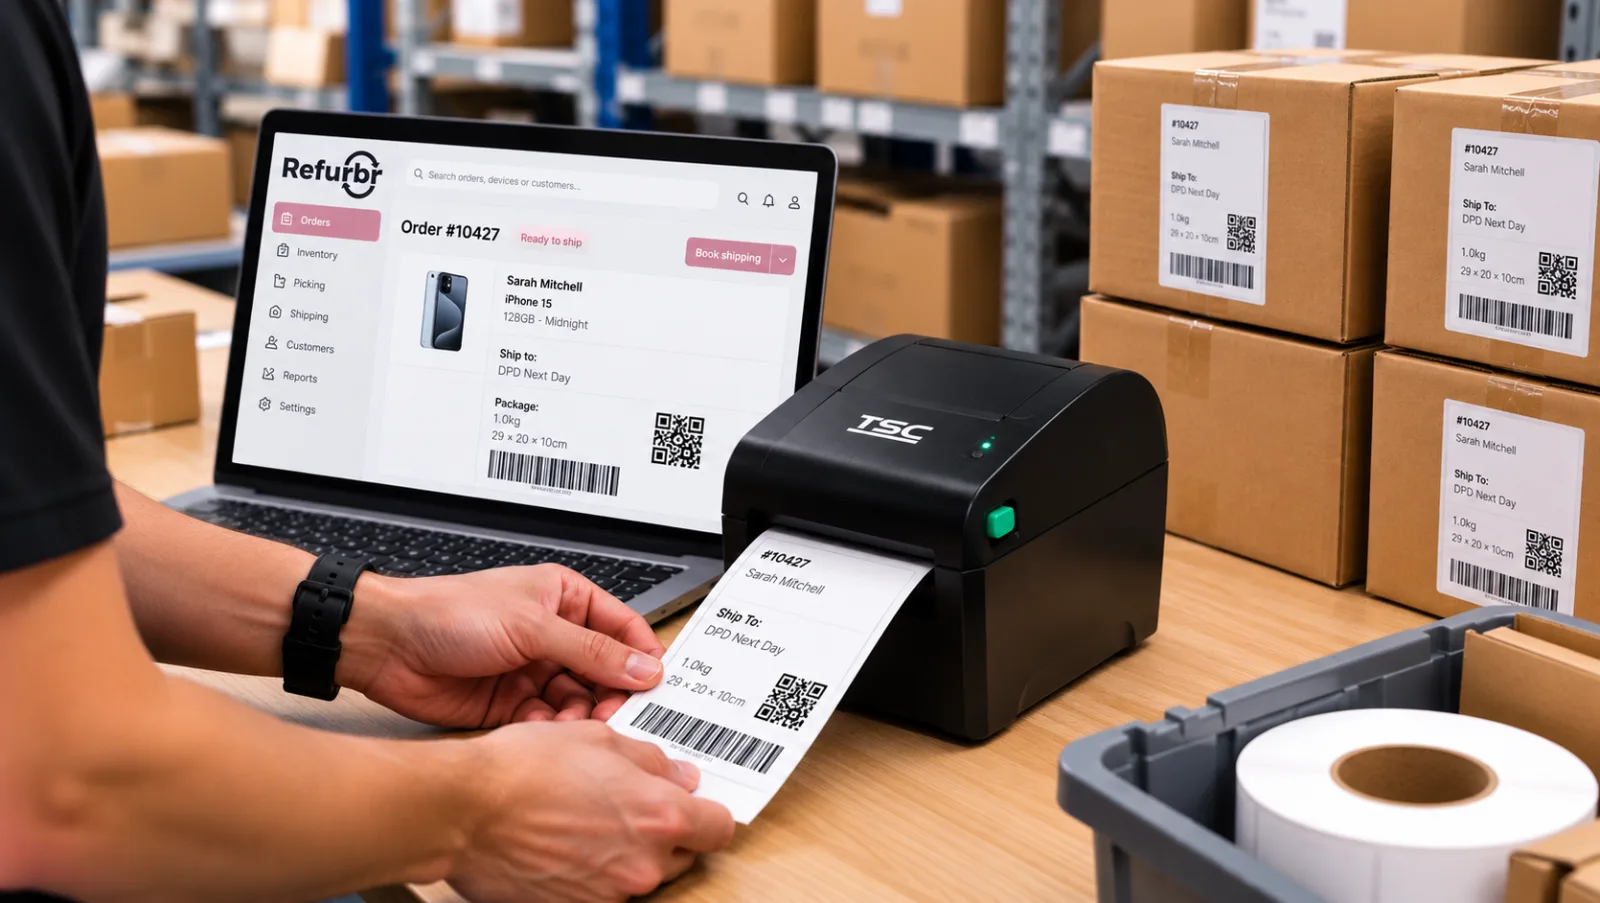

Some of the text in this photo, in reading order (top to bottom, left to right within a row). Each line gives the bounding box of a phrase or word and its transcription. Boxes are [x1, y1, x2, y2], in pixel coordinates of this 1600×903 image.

[1172, 120, 1199, 130] #10427
[1172, 137, 1220, 150] Sarah Mitchell
[1465, 144, 1499, 156] #10427
[282, 157, 383, 185] Refurbr
[1171, 171, 1197, 182] Ship To:
[1464, 162, 1525, 177] Sarah Mitchell
[429, 171, 456, 181] Search
[458, 173, 486, 184] orders,
[488, 176, 519, 186] devices
[521, 179, 529, 187] or
[1171, 185, 1220, 201] DPD Next Day
[1463, 199, 1497, 212] Ship To:
[301, 216, 331, 227] Orders
[1171, 213, 1190, 225] 1.0kg
[1462, 214, 1526, 233] DPD Next Day
[401, 220, 500, 241] Order #10427
[1185, 231, 1194, 240] 20
[1201, 233, 1219, 244] 10cm
[521, 233, 582, 249] Ready to ship
[297, 248, 338, 262] Inventory
[695, 248, 761, 265] Book shipping
[1461, 248, 1486, 261] 1.0kg
[507, 275, 583, 292] Sarah Mitchell
[1461, 267, 1471, 277] 29
[1481, 269, 1492, 280] 20
[1502, 271, 1525, 285] 10cm
[294, 278, 326, 292] Picking
[505, 294, 552, 308] iPhone 15
[290, 309, 329, 323] Shipping
[504, 312, 535, 324] 128GB
[545, 316, 589, 331] Midnight
[286, 340, 335, 354] Customers
[500, 348, 537, 362] Ship to:
[283, 371, 318, 384] Reports
[498, 365, 571, 385] DPD Next Day
[280, 401, 316, 415] Settings
[495, 398, 539, 413] Package:
[494, 413, 521, 428] 1.0kg
[857, 414, 934, 441] TSC
[1456, 416, 1490, 431] #10427
[492, 430, 504, 441] 29
[516, 434, 529, 444] 20
[541, 437, 568, 450] 10cm
[1456, 434, 1517, 455] Sarah Mitchell
[1454, 470, 1489, 486] Ship To:
[1454, 484, 1517, 510] DPD Next Day
[1453, 516, 1477, 532] 1.0kg
[1452, 533, 1462, 544] 29
[1472, 539, 1482, 549] 20
[1492, 545, 1514, 560] 10cm
[761, 550, 811, 569] #10427
[746, 568, 826, 596] Sarah Mitchell
[717, 607, 763, 628] Ship To:
[704, 625, 785, 657] DPD Next Day
[681, 657, 713, 676] 1.0kg
[666, 675, 682, 688] 29
[691, 682, 708, 696] 20
[717, 690, 746, 708] 10cm
